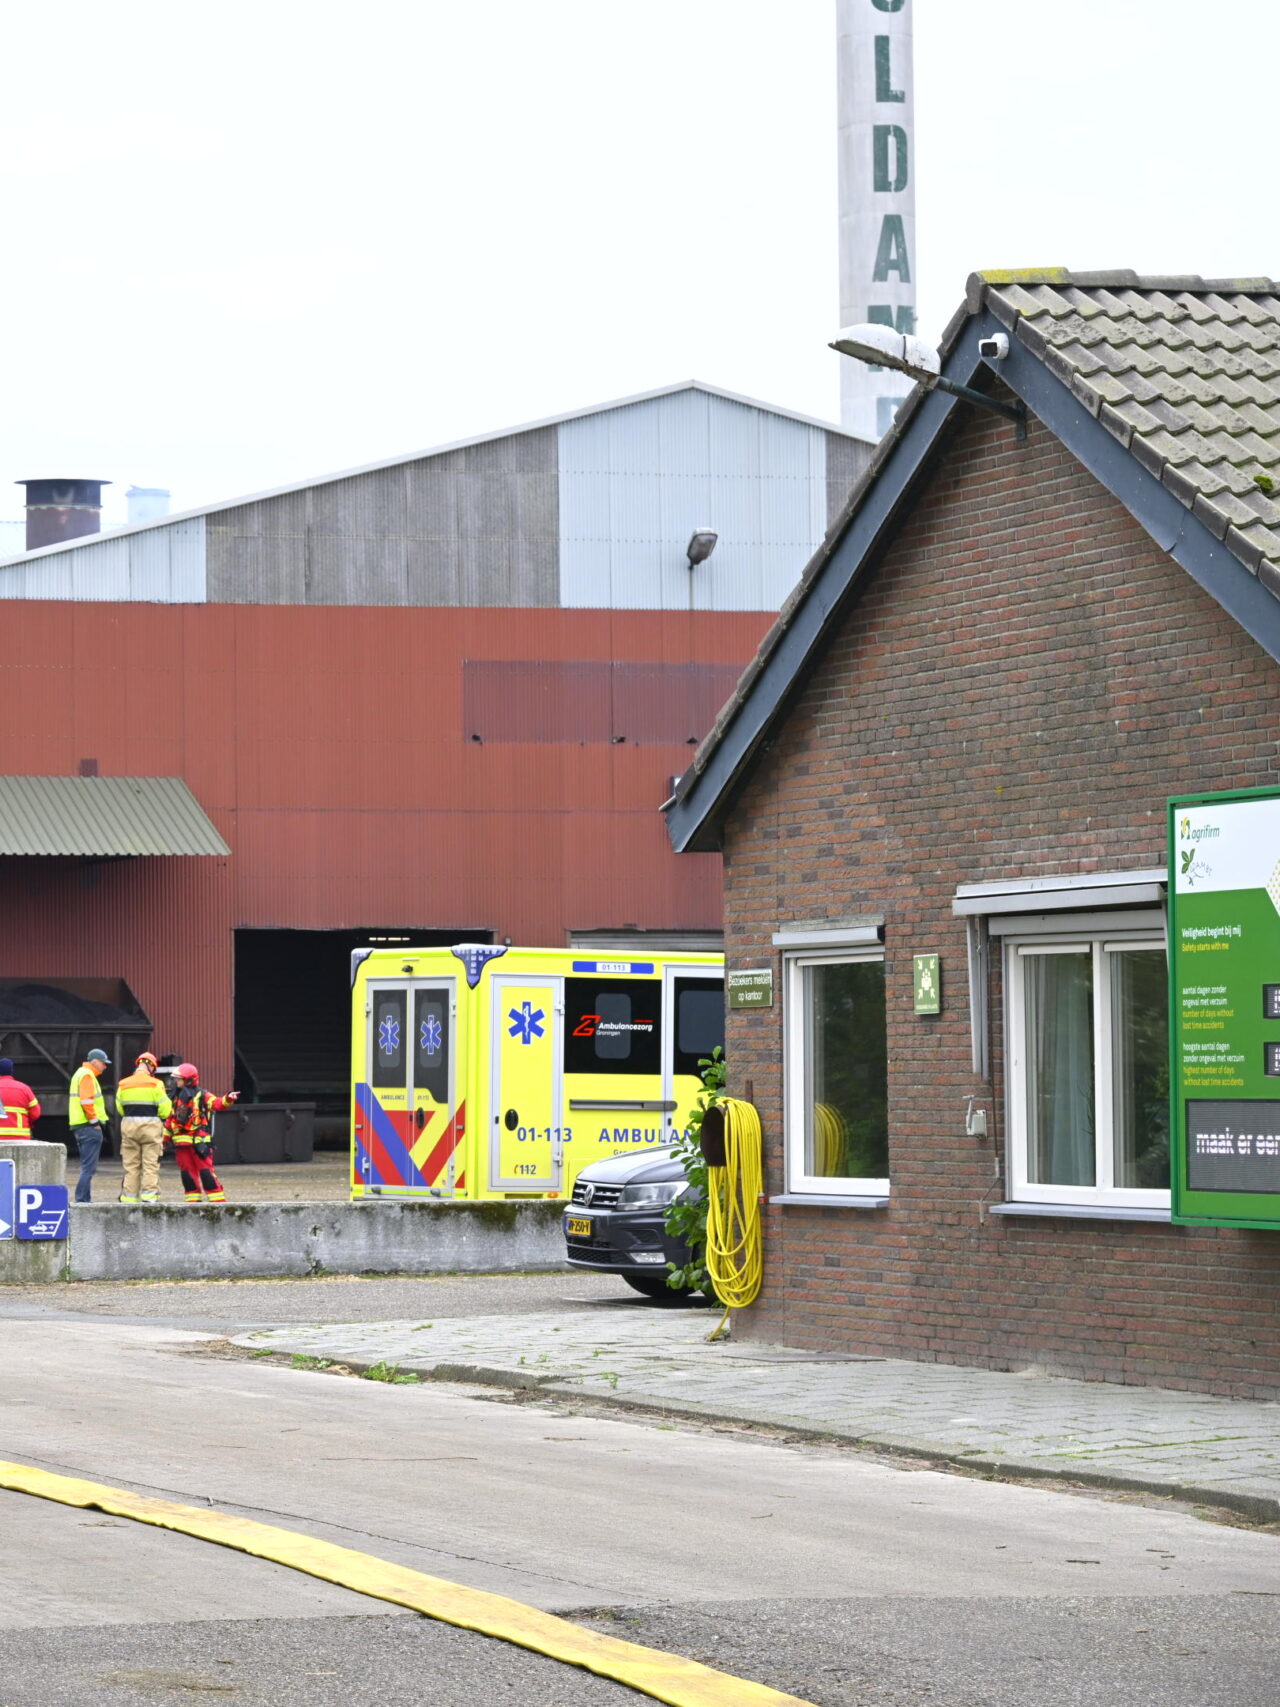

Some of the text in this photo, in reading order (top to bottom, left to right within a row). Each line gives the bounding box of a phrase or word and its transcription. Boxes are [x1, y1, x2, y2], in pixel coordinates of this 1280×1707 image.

[1192, 824, 1220, 843] agrifirm
[1182, 927, 1207, 940] Veiligheid
[1208, 926, 1224, 938] begint
[1233, 924, 1242, 937] mij
[1197, 943, 1210, 951] starts
[1211, 942, 1221, 950] with
[729, 973, 771, 986] Bezoekers melden
[1197, 986, 1211, 996] dagen
[1211, 985, 1227, 994] zonder
[738, 990, 763, 1004] op kantoor
[1200, 998, 1209, 1006] met
[598, 1022, 653, 1032] Ambulancezorg
[1216, 1042, 1230, 1052] dagen
[1183, 1054, 1198, 1062] zonder
[1217, 1054, 1226, 1062] met
[517, 1127, 573, 1142] 01-113
[1196, 1127, 1235, 1154] maak
[1237, 1134, 1253, 1154] er
[520, 1164, 537, 1175] 112
[19, 1188, 43, 1224] P
